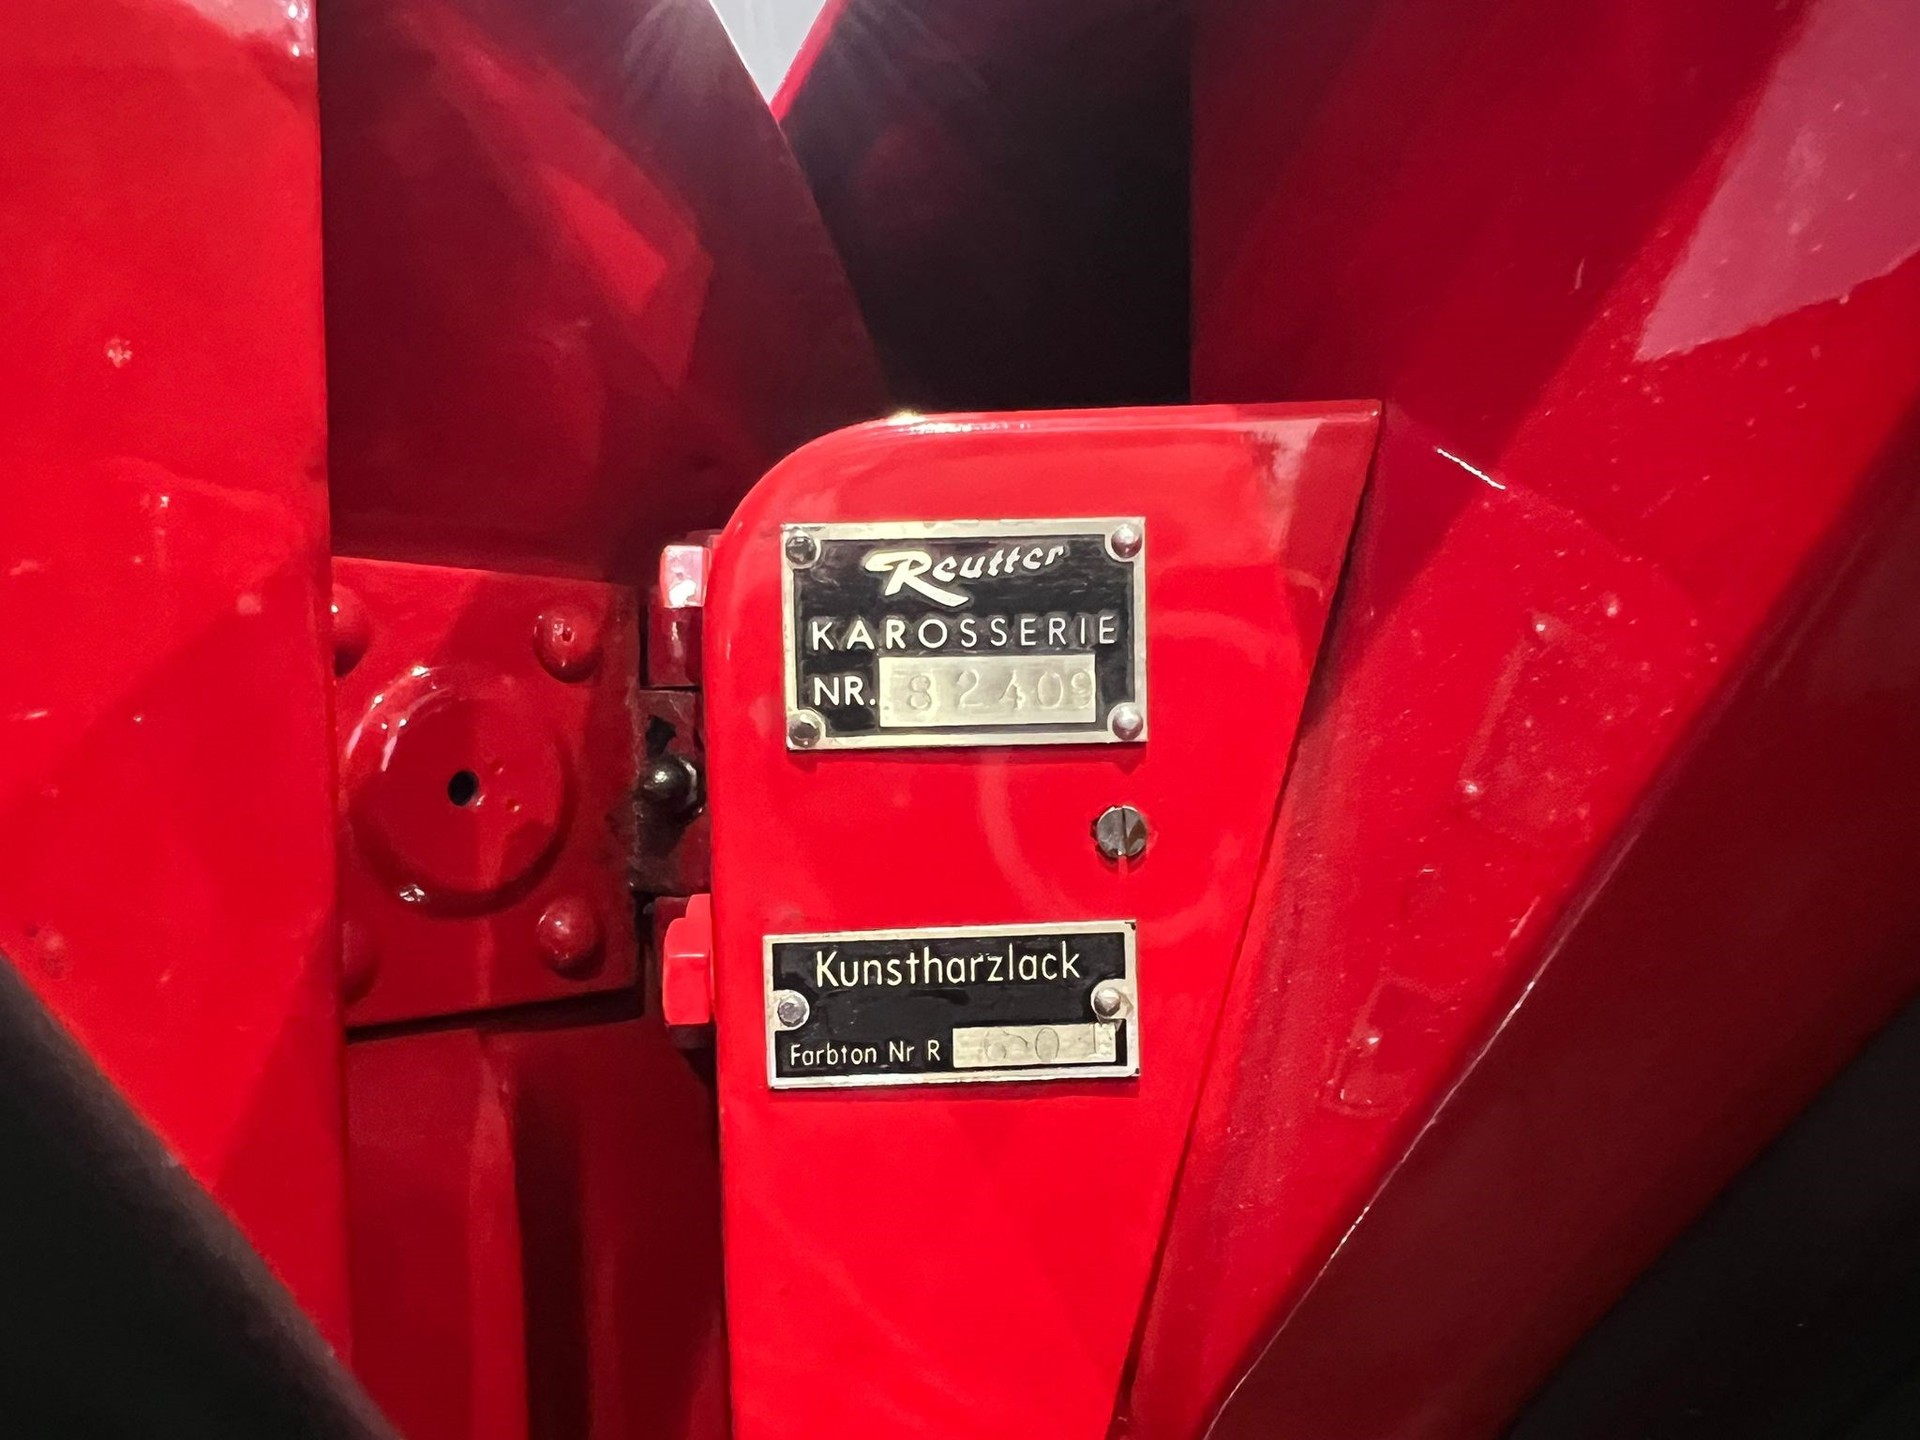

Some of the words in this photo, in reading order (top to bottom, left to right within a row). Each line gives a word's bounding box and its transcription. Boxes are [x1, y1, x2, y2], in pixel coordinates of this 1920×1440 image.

[864, 545, 1065, 607] Reutter
[811, 614, 1117, 651] KAROSSERIE
[812, 675, 877, 707] NR.
[907, 667, 1095, 712] 82409
[815, 940, 1080, 988] Kunstharzlack
[790, 1042, 877, 1066] Farbton
[888, 1039, 915, 1063] Nr
[927, 1039, 941, 1062] R
